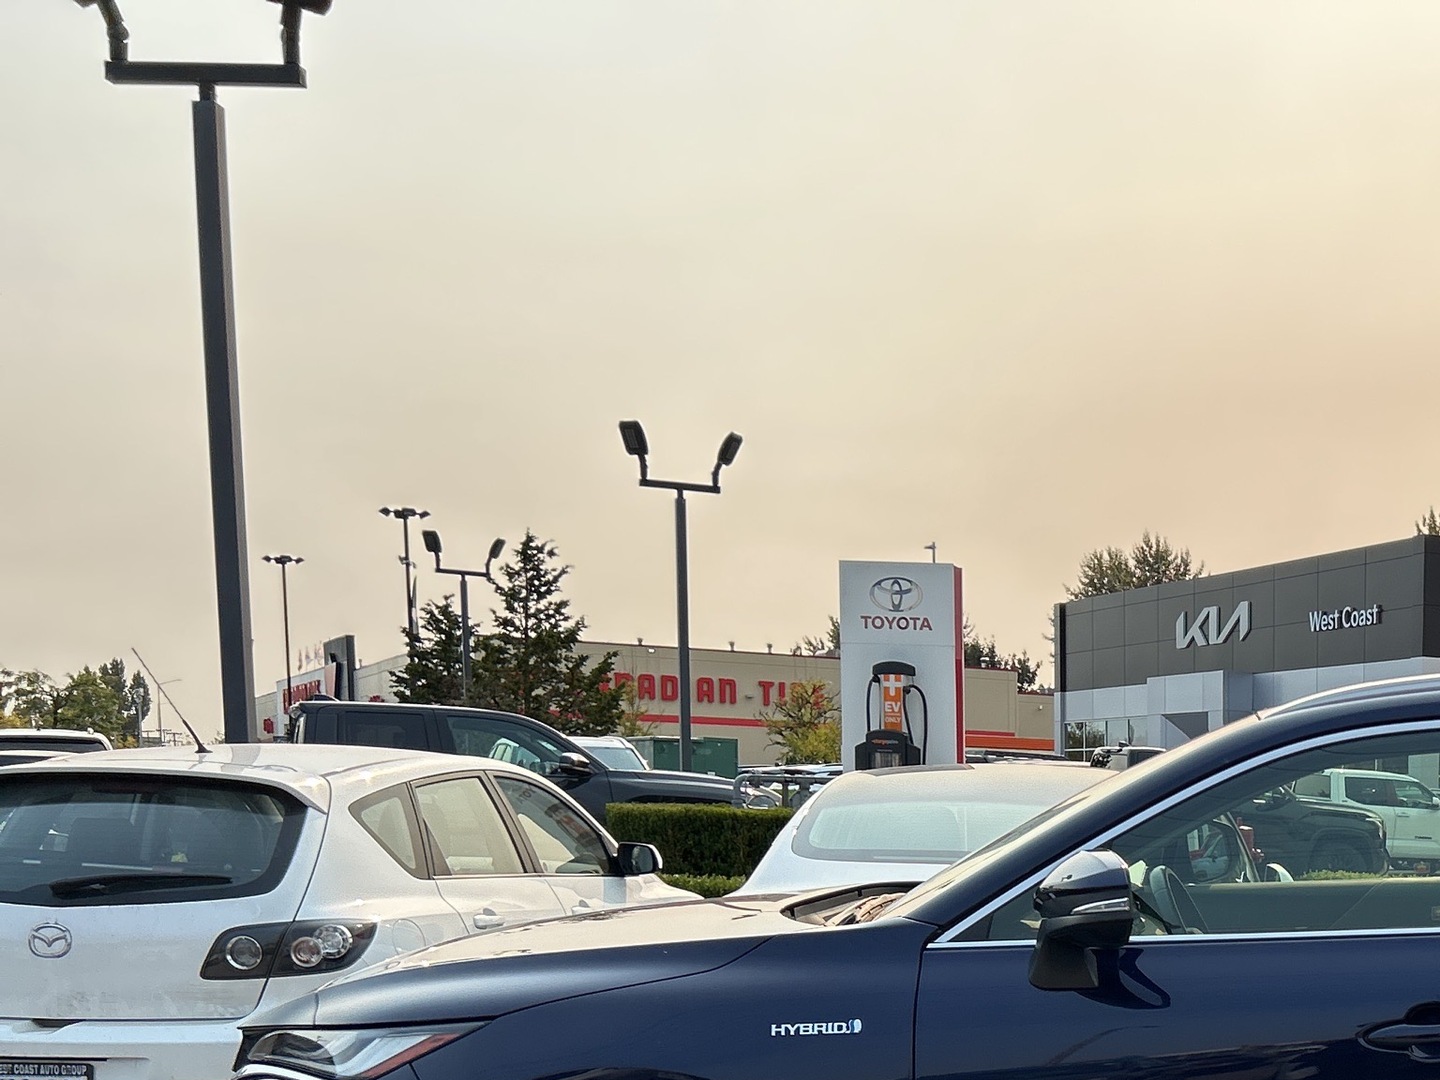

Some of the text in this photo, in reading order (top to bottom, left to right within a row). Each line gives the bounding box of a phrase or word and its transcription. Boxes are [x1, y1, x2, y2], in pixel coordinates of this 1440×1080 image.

[860, 615, 933, 631] TOYOTA
[1176, 600, 1251, 649] KIA
[1309, 604, 1380, 632] West Coast
[884, 701, 901, 712] EV
[771, 1022, 848, 1036] HYBRID
[13, 1064, 38, 1075] COAST
[40, 1064, 60, 1075] AUTO
[61, 1064, 87, 1075] GROUP
